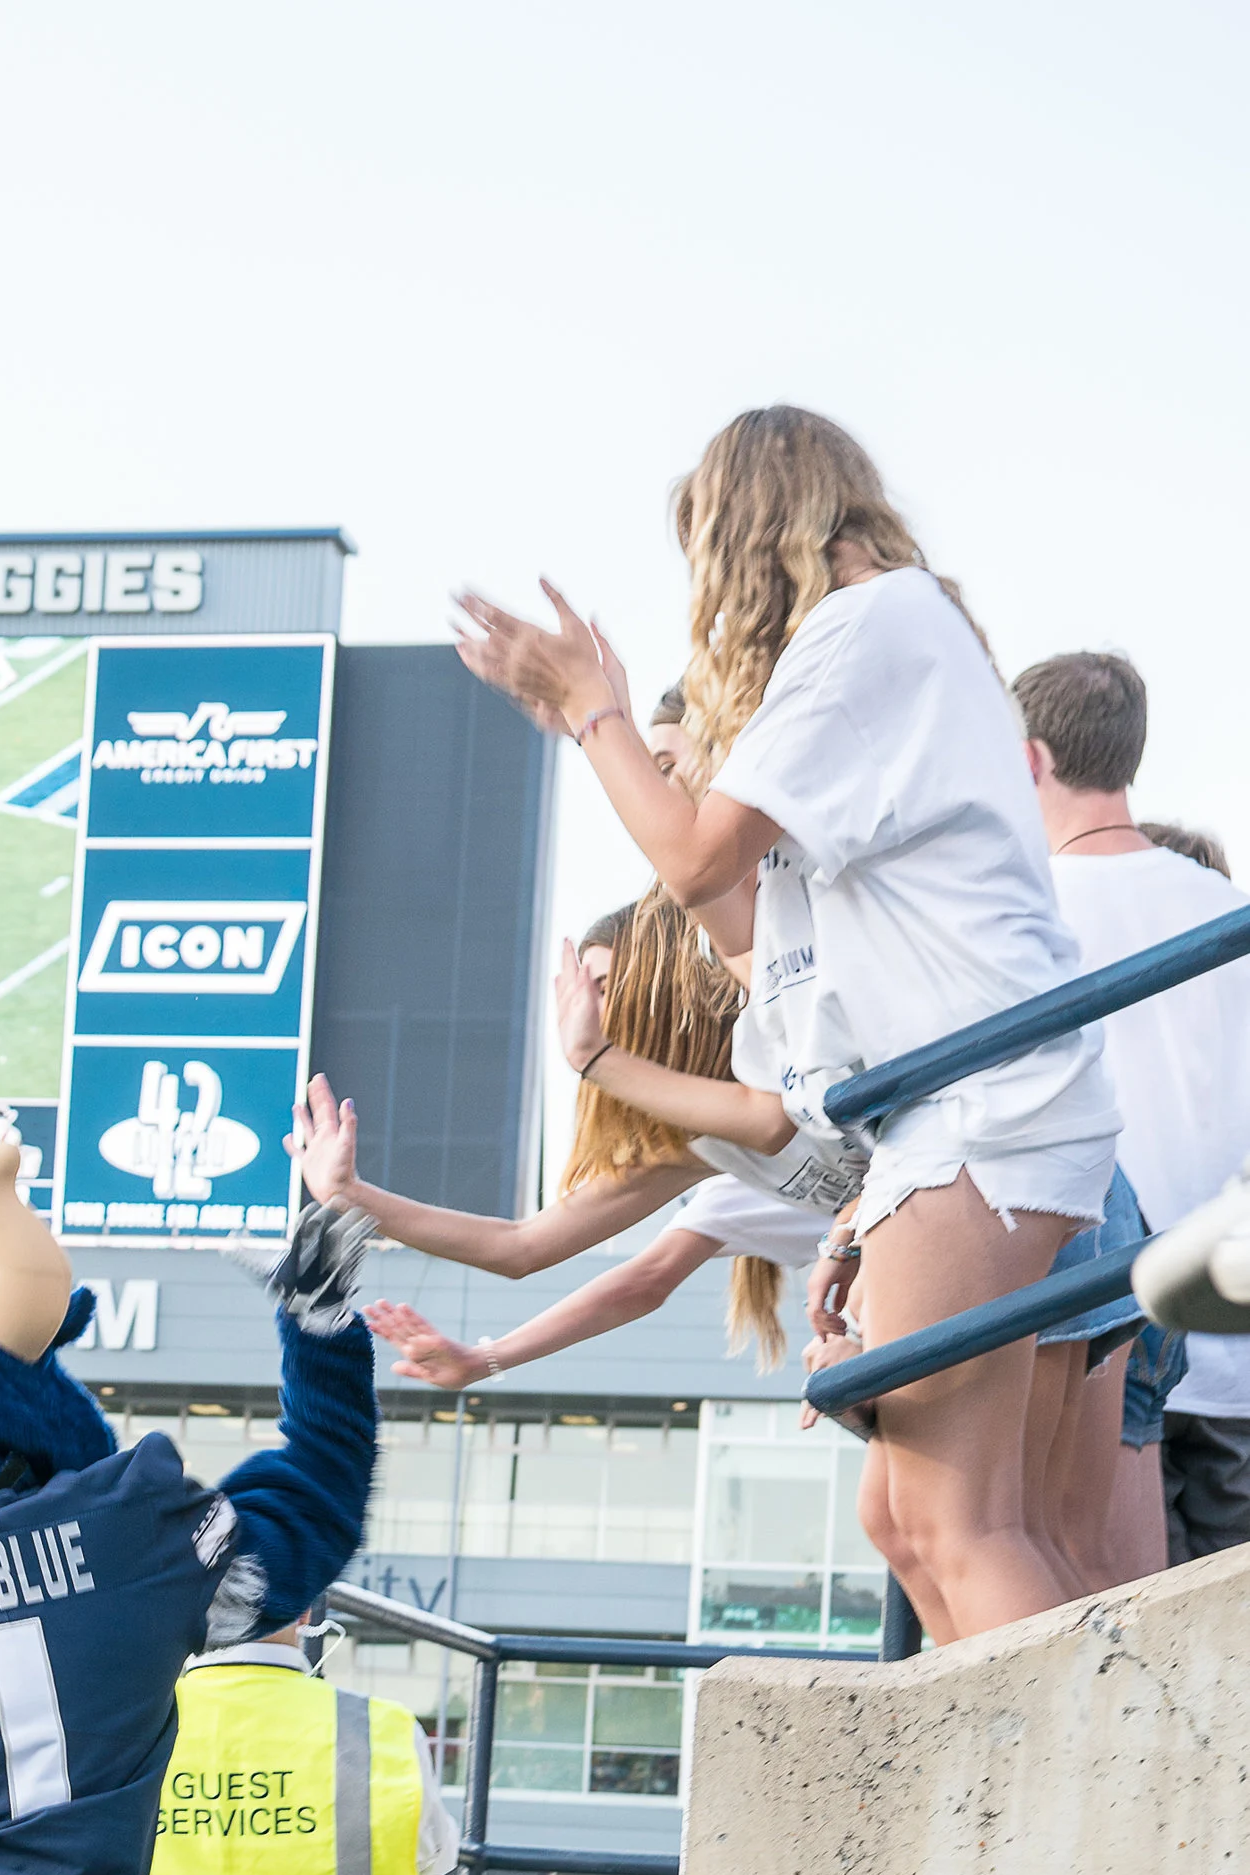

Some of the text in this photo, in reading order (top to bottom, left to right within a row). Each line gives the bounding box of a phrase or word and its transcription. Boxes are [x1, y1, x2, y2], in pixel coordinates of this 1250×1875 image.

[92, 738, 318, 769] AMERICA FIRST
[120, 924, 265, 969] ICON
[172, 1770, 294, 1801] GUEST
